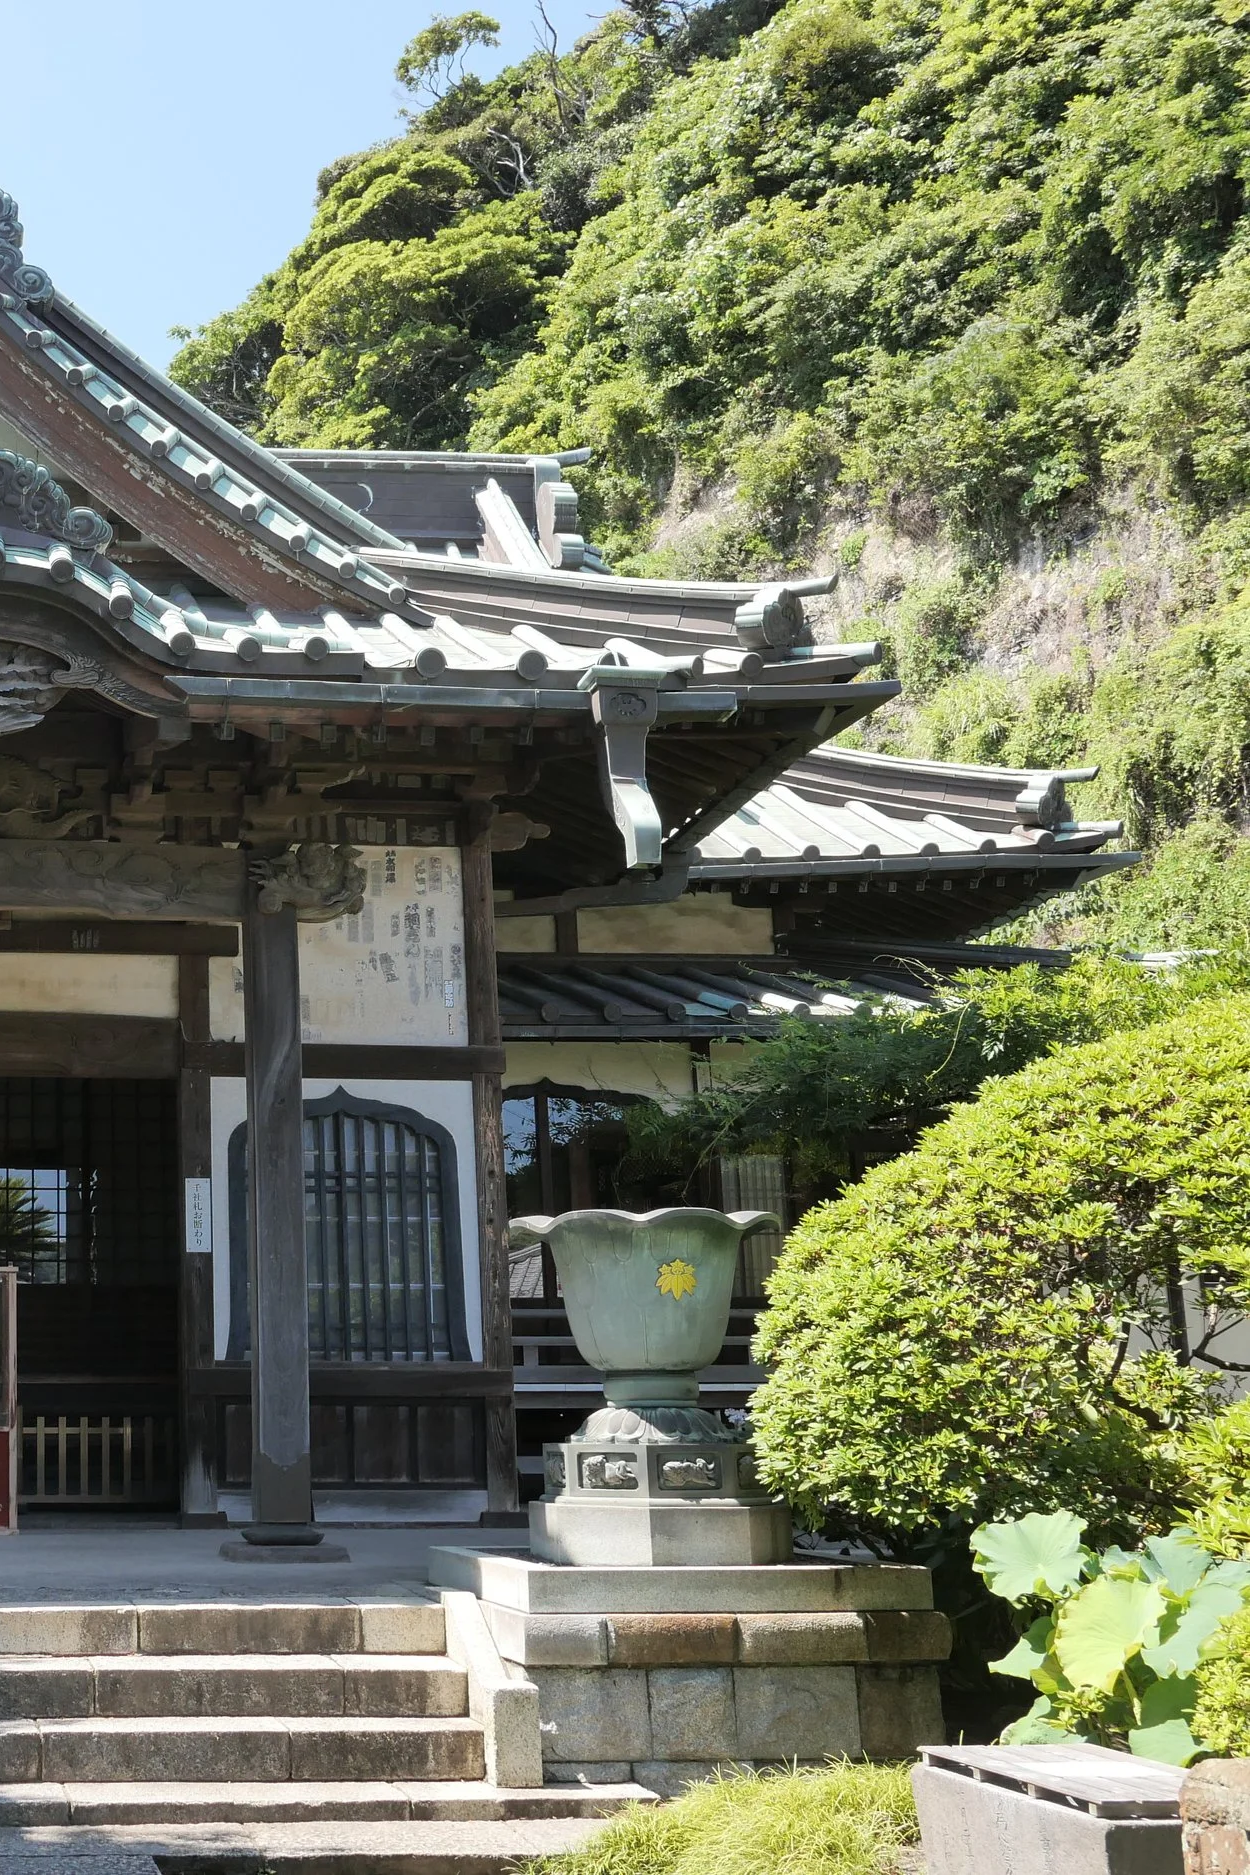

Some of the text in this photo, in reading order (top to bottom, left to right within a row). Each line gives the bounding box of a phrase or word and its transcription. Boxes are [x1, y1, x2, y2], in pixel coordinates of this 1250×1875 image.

[191, 1183, 203, 1247] 千社札お断わり
